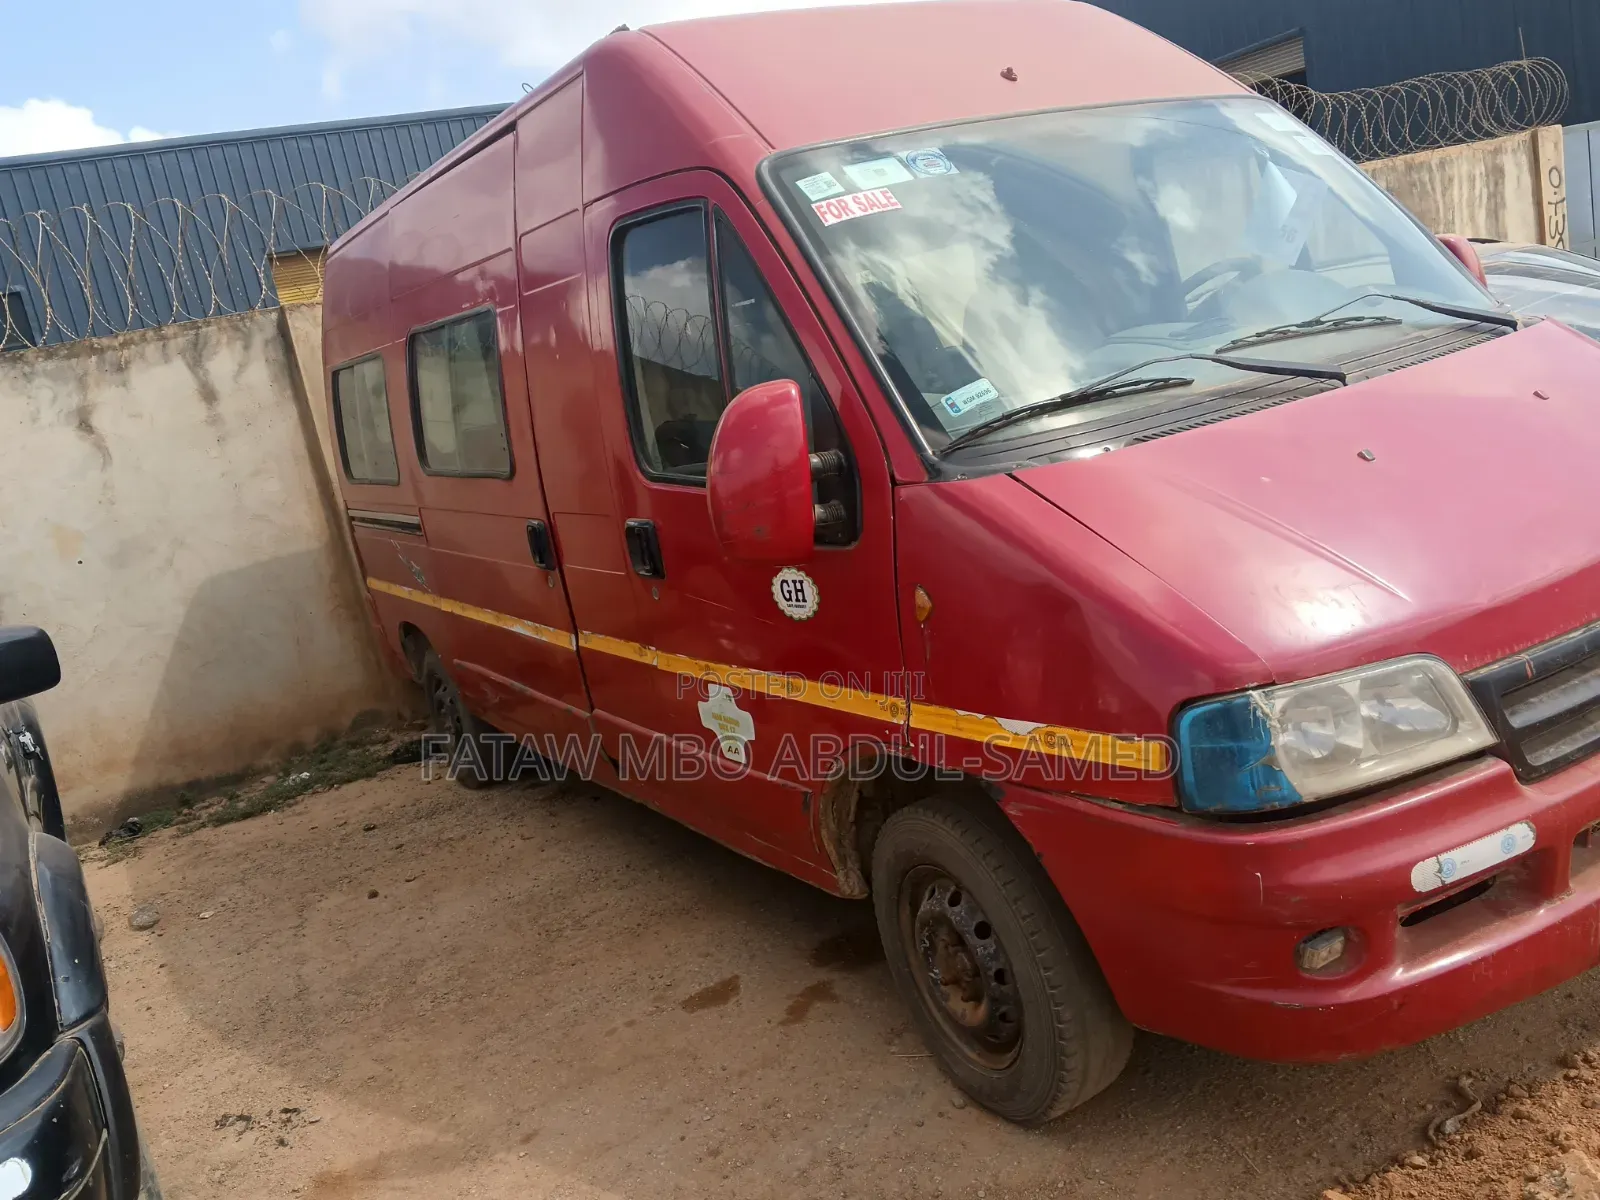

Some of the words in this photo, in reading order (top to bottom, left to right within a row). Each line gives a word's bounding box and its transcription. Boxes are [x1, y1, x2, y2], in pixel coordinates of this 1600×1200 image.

[814, 199, 855, 223] FOR
[851, 189, 901, 214] SALE
[780, 579, 807, 603] GH
[727, 745, 740, 756] AA
